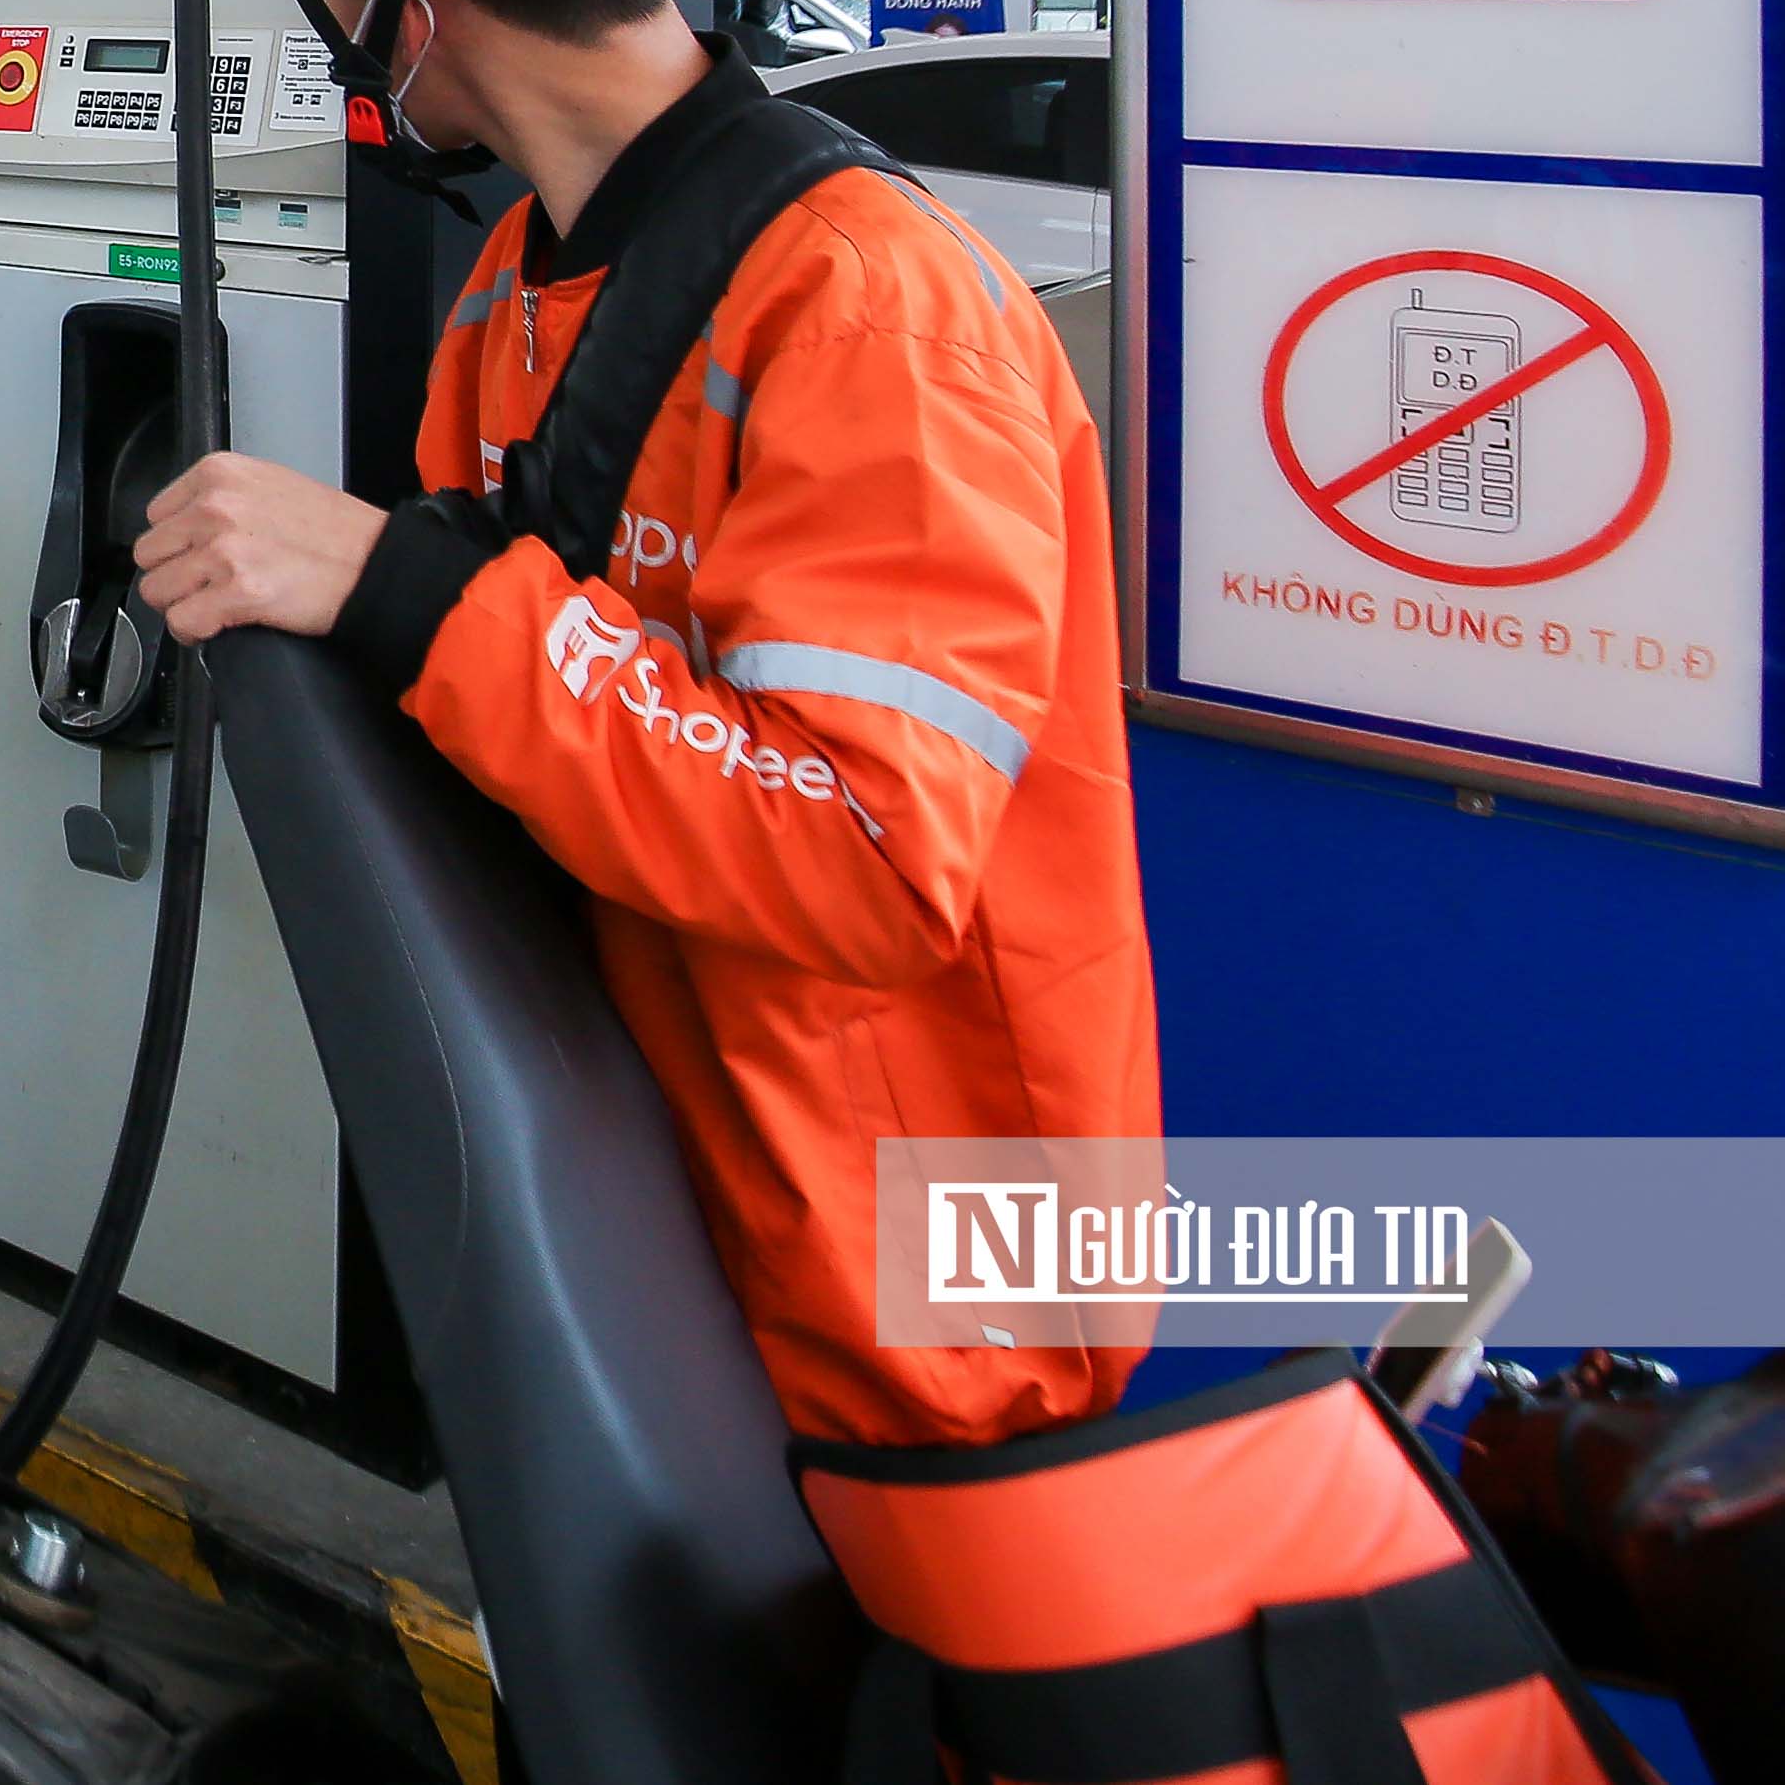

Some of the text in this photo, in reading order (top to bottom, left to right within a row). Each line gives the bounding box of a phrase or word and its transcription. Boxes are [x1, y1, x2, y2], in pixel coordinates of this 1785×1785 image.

[235, 61, 248, 72] F1
[232, 81, 245, 91] F2
[79, 95, 160, 108] P1 P2 P3 P4 P5
[230, 101, 242, 111] F3
[76, 114, 158, 128] P6 P7 P8 P9 P10
[226, 120, 240, 131] F4
[1433, 346, 1476, 367] Đ.T
[1220, 569, 1718, 682] KHÔNG DÙNG Đ.T.D.Đ
[616, 658, 835, 801] Shopee
